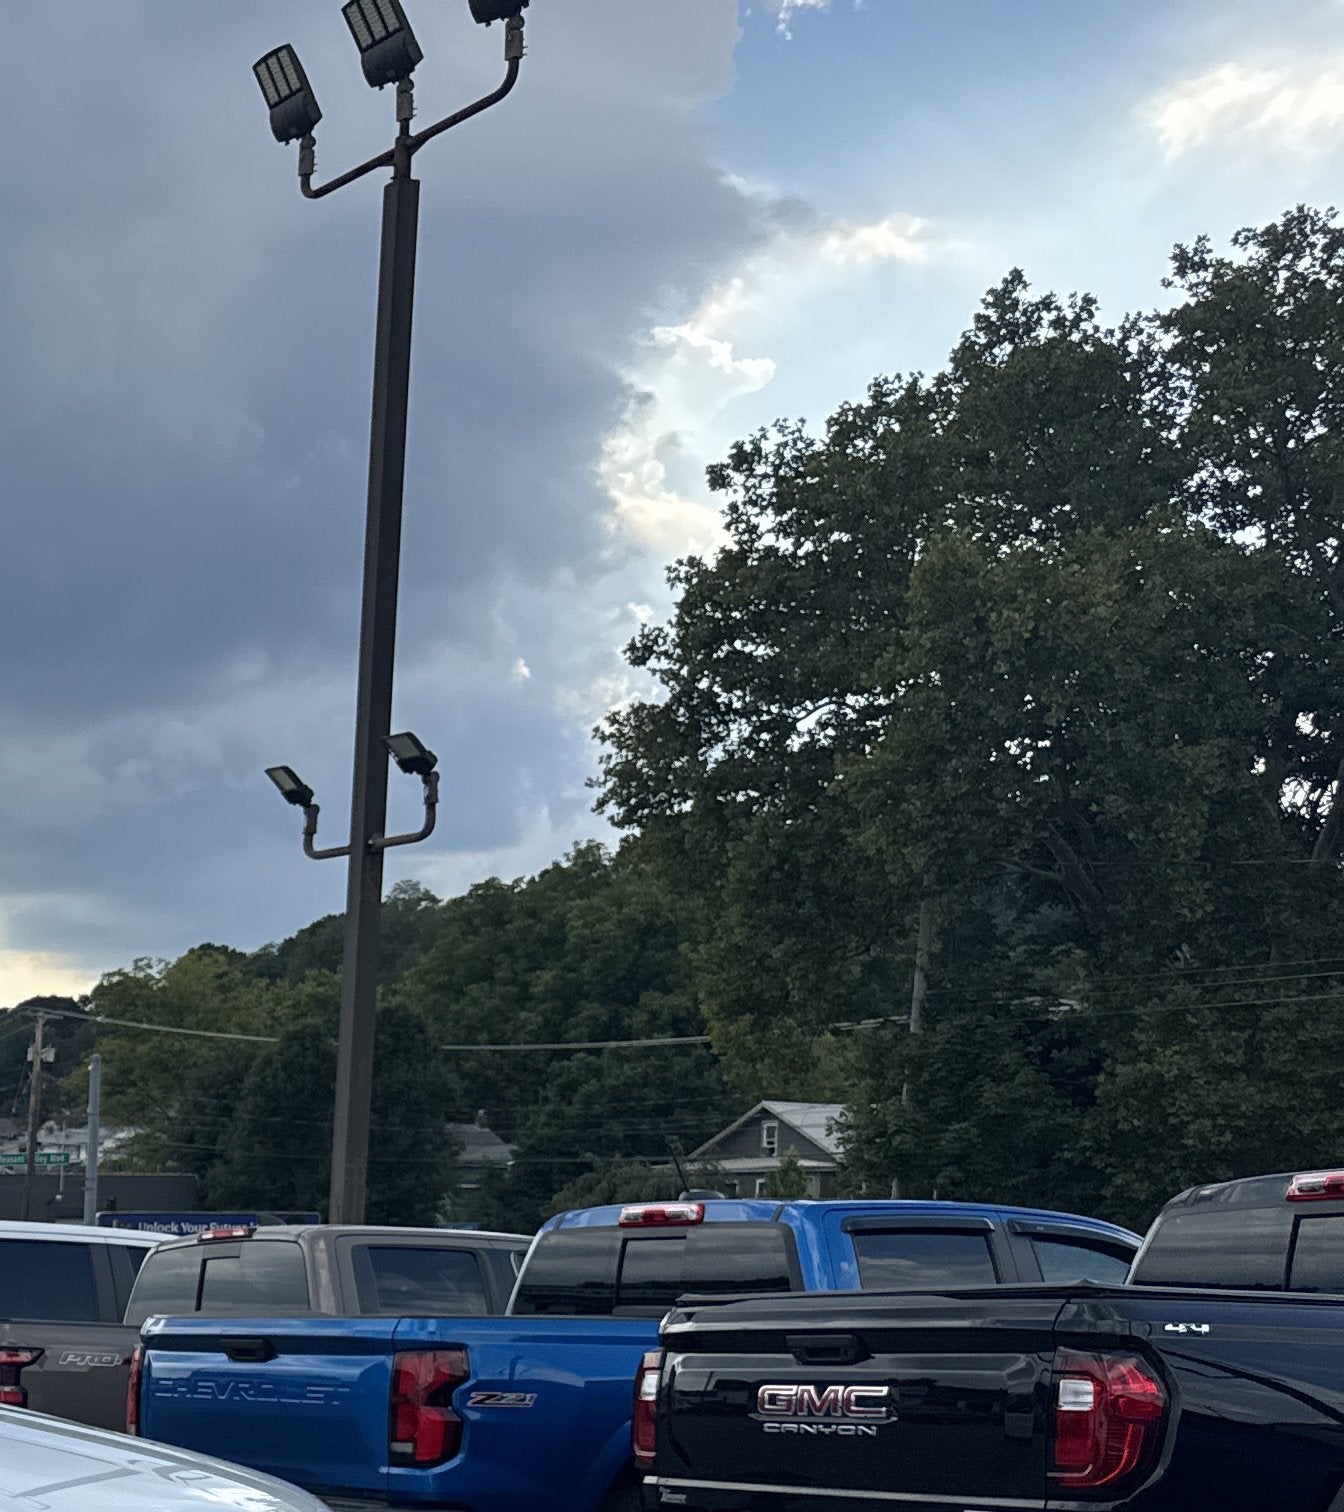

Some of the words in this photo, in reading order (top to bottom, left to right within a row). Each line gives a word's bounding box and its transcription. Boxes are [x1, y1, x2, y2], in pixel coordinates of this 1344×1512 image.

[138, 1221, 179, 1233] Unlock
[180, 1222, 208, 1233] Your
[155, 1379, 352, 1406] CHEVROLET
[465, 1391, 539, 1408] Z71
[757, 1384, 890, 1418] GMC
[763, 1422, 878, 1437] CANYON
